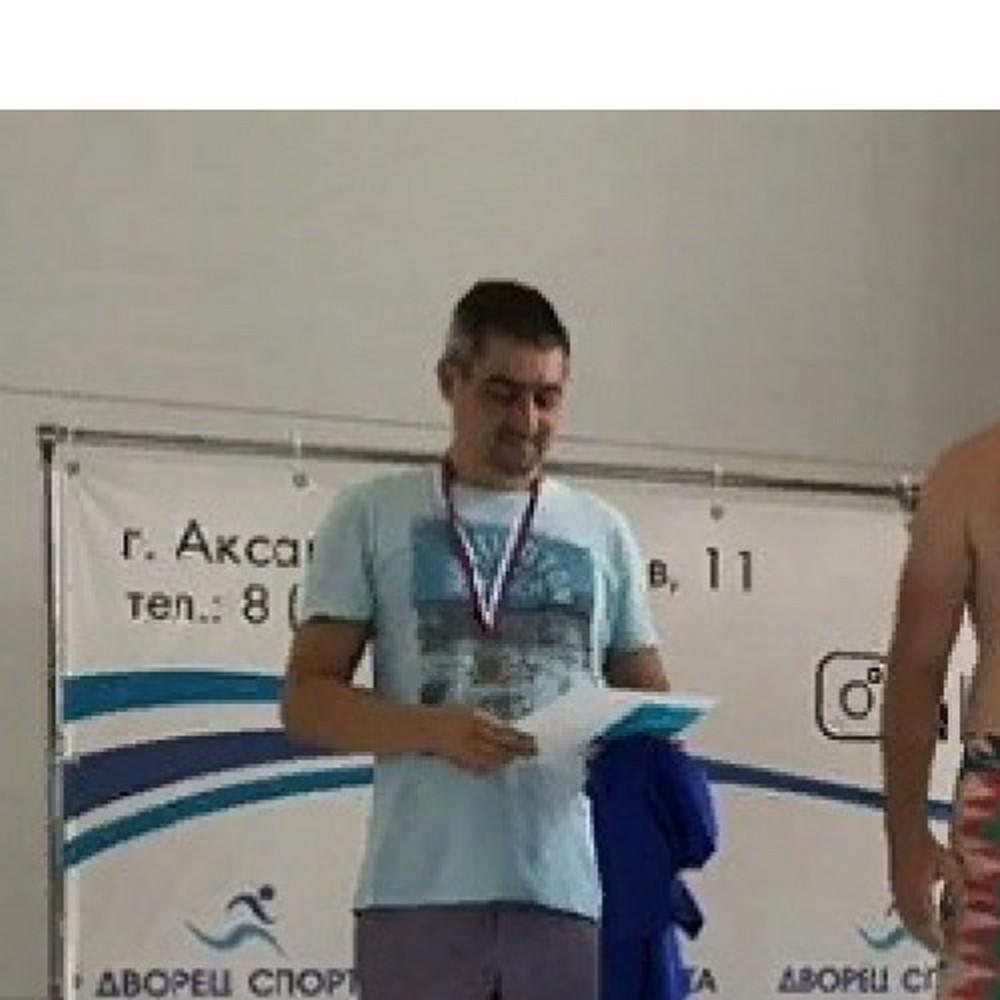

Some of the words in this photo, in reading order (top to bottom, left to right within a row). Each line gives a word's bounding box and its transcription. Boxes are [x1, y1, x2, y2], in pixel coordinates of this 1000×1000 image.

[122, 528, 155, 560] г.
[706, 547, 752, 592] 11
[243, 583, 269, 624] 8
[96, 968, 233, 998] ДВОРЕЦ
[248, 968, 360, 998] СПОРТ
[778, 967, 889, 993] ДВОРЕЦ
